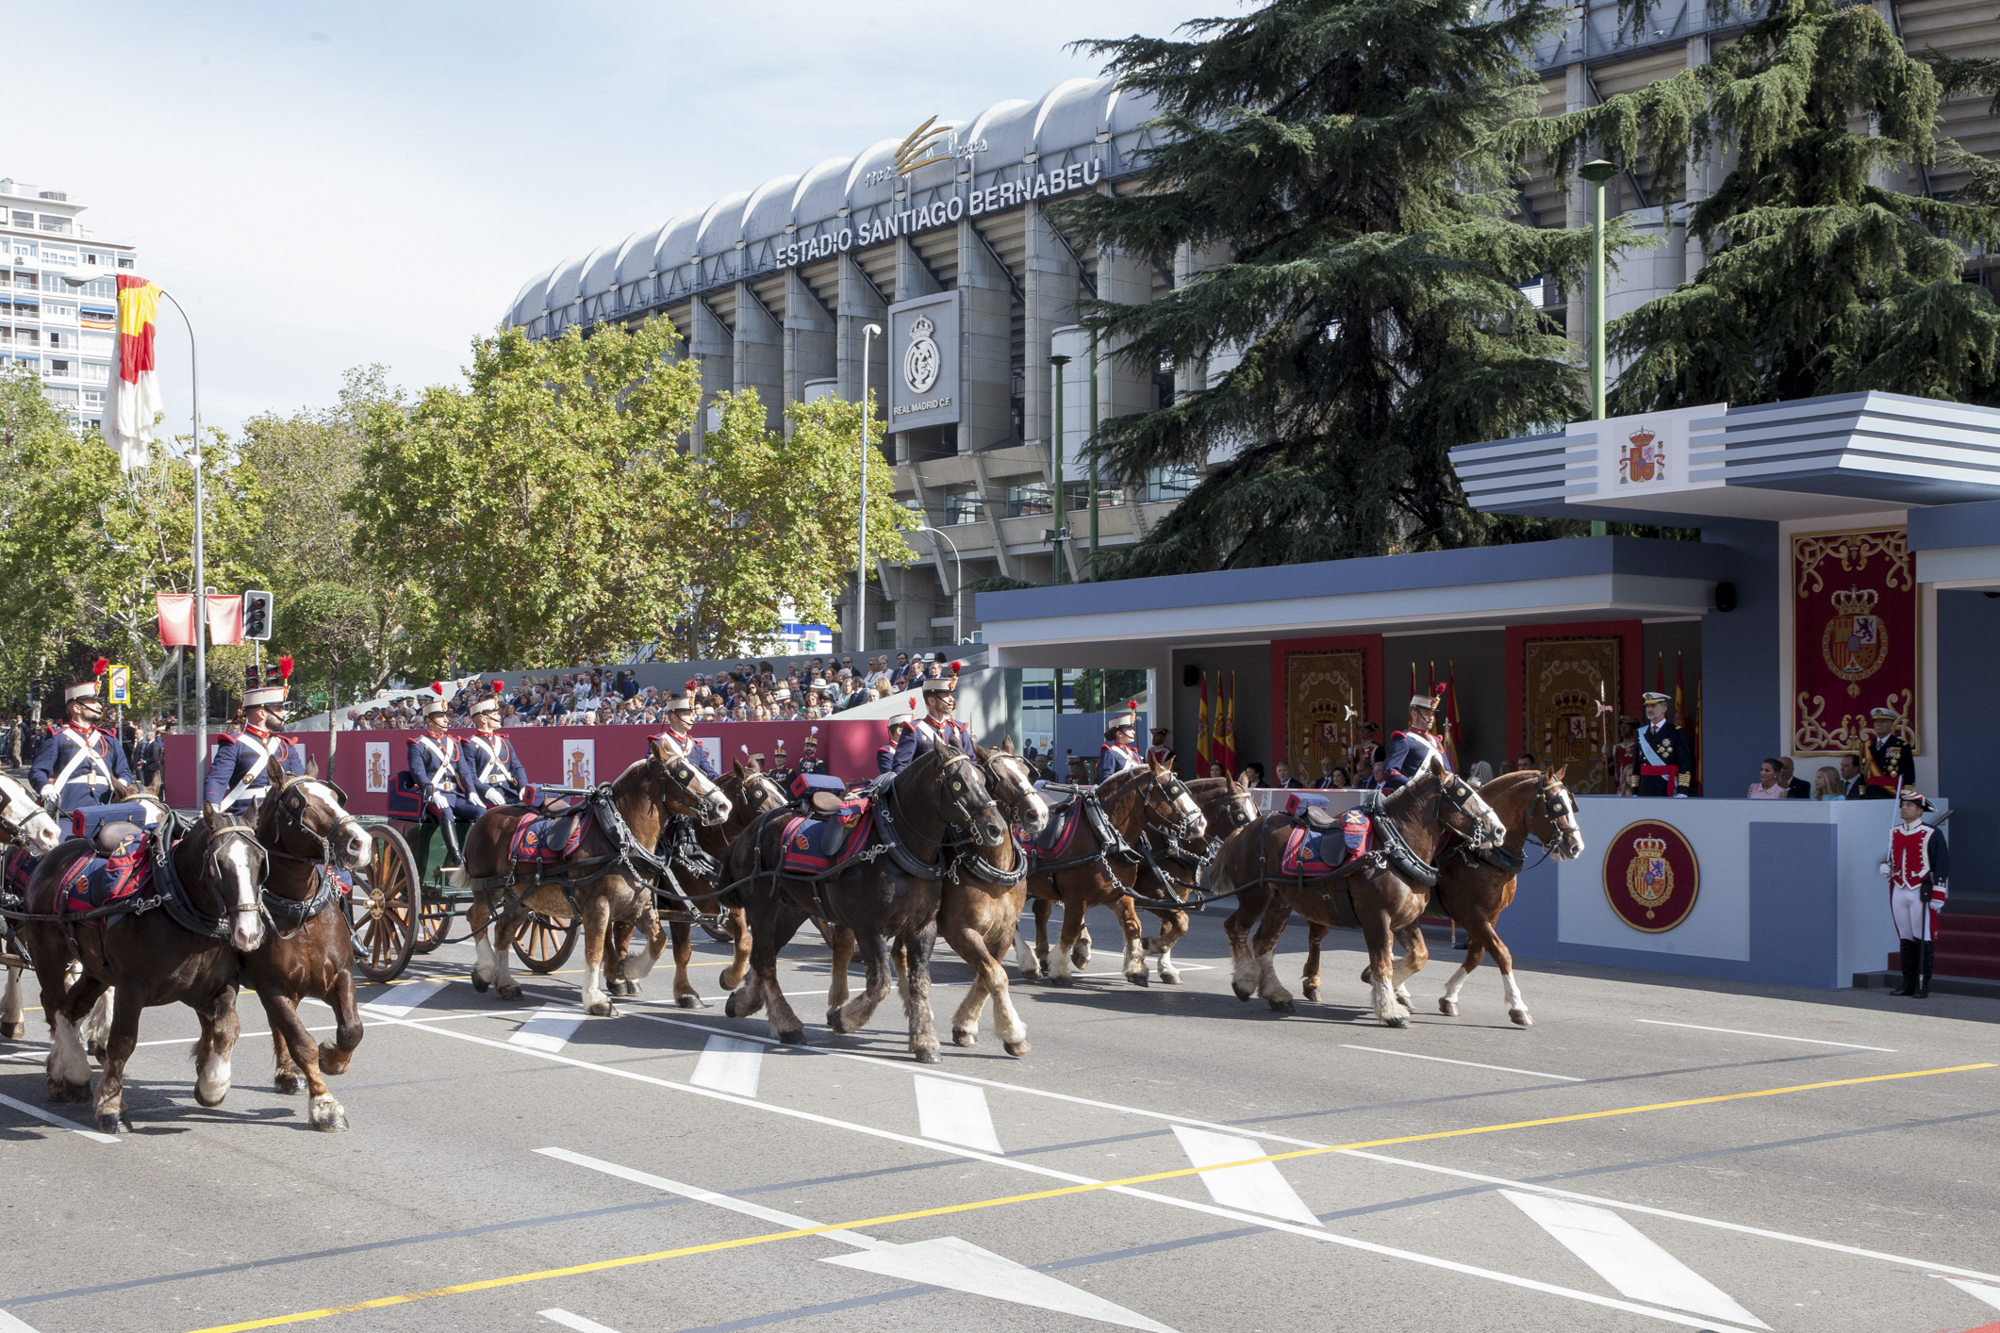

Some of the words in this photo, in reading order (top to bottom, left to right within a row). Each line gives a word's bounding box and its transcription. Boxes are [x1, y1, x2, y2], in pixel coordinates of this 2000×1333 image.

[776, 227, 852, 270] ESTADIO
[858, 196, 963, 246] SANTIAGO
[969, 157, 1100, 216] BERNABEU
[893, 404, 912, 416] REAL
[912, 399, 939, 412] MADRID
[939, 397, 951, 407] C.F.
